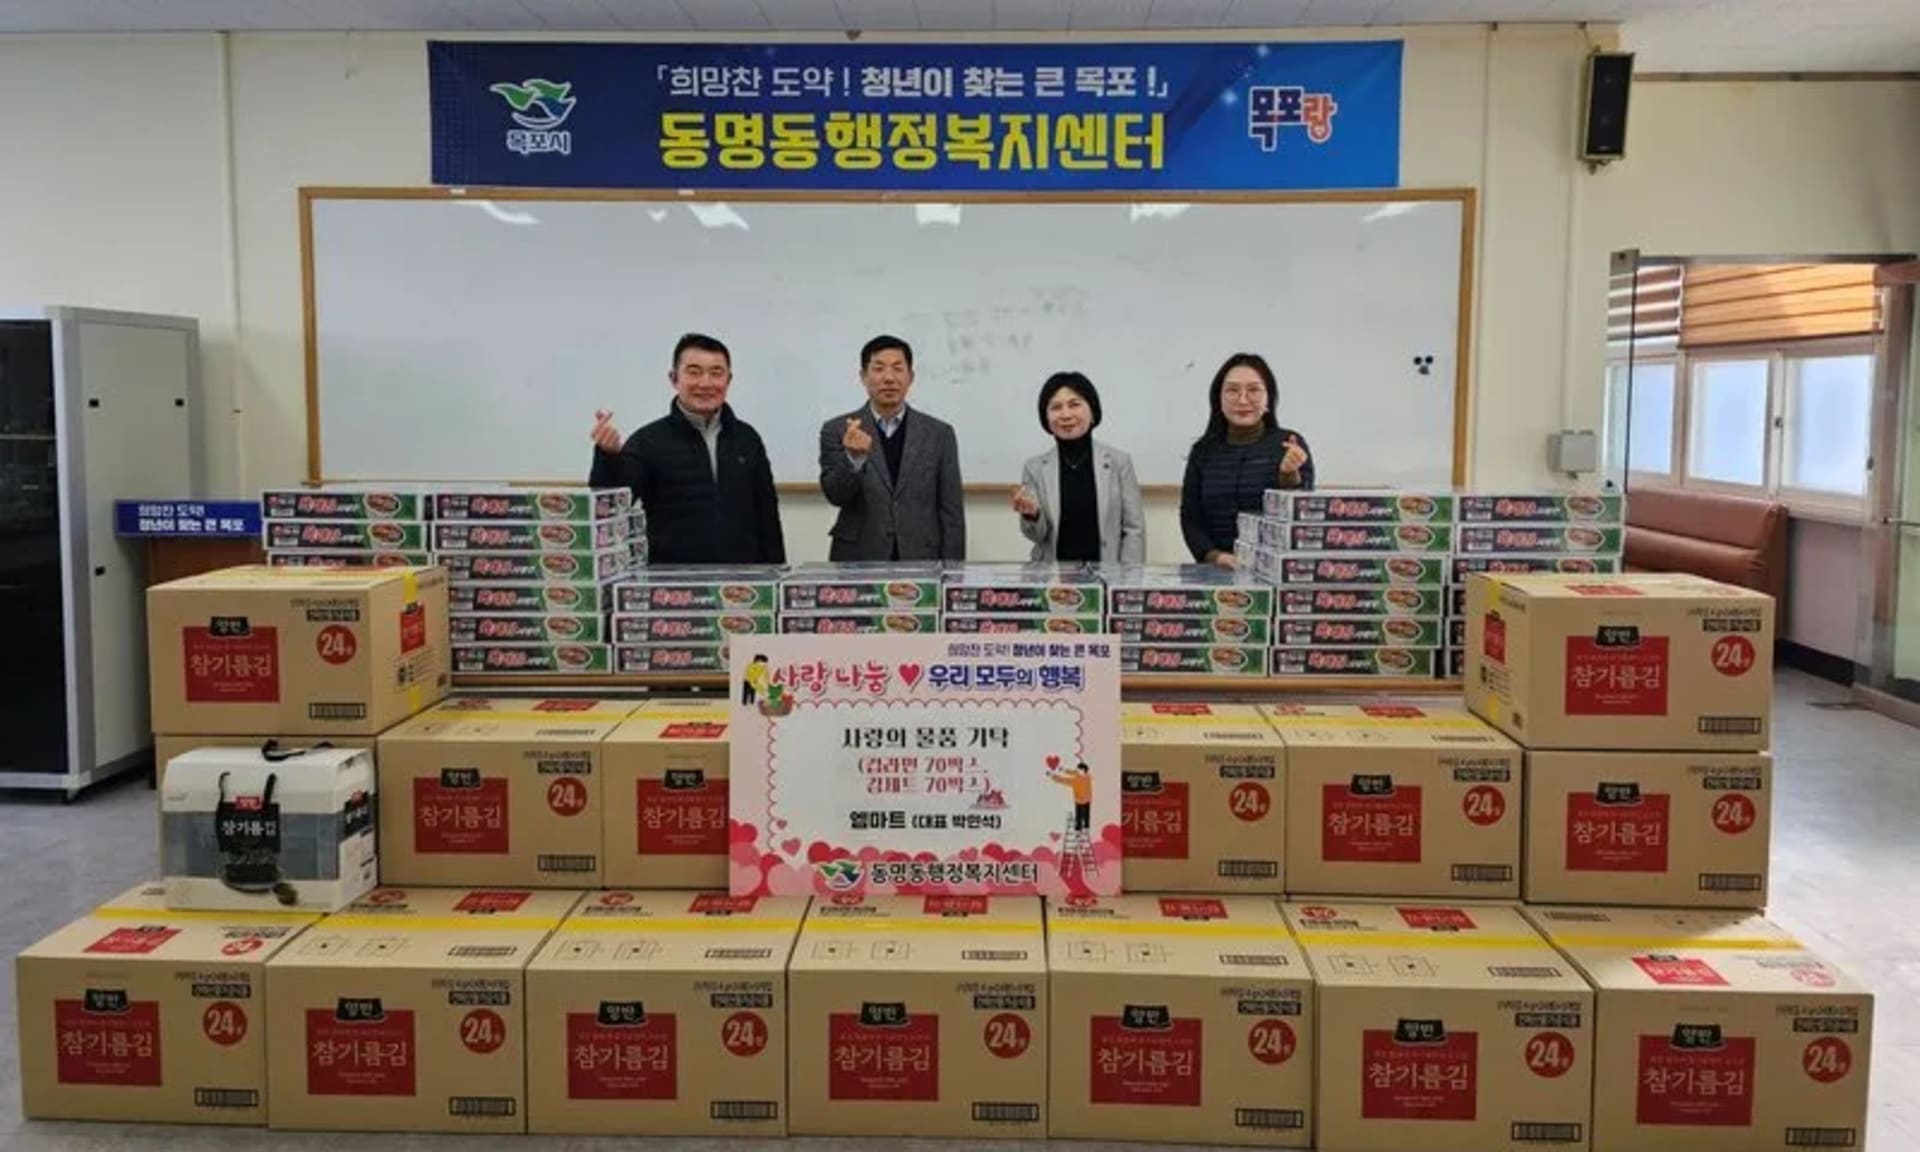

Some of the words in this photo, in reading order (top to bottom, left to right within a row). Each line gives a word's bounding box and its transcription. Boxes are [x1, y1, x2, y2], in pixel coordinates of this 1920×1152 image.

[861, 67, 953, 97] 청년이
[963, 66, 1024, 97] 찾는
[1035, 67, 1065, 97] 큰
[1075, 66, 1137, 98] 목포
[659, 112, 1165, 170] 동명동행정복지센터
[191, 654, 272, 678] 참기름김
[771, 661, 828, 693] 사랑
[929, 664, 969, 687] 우리
[976, 664, 1033, 687] 모두의
[1039, 664, 1081, 688] 행복
[1571, 665, 1661, 689] 참기름김
[842, 727, 906, 748] 사랑의
[916, 727, 957, 748] 물품
[967, 727, 1009, 748] 기탁
[420, 806, 500, 828] 참기름김
[643, 806, 725, 829] 참기름김
[912, 814, 947, 829] (대표
[1328, 812, 1414, 837] 참기름김
[1573, 821, 1661, 845] 참기름김
[871, 863, 1038, 883] 동명동행정복지센터
[62, 1031, 152, 1057] 참기름김
[312, 1040, 407, 1067] 참기름김
[574, 1044, 669, 1070] 참기름김
[834, 1045, 930, 1071] 참기름김
[1098, 1048, 1192, 1076] 참기름김
[1368, 1063, 1468, 1090] 참기름김
[1643, 1068, 1744, 1096] 참기름김
